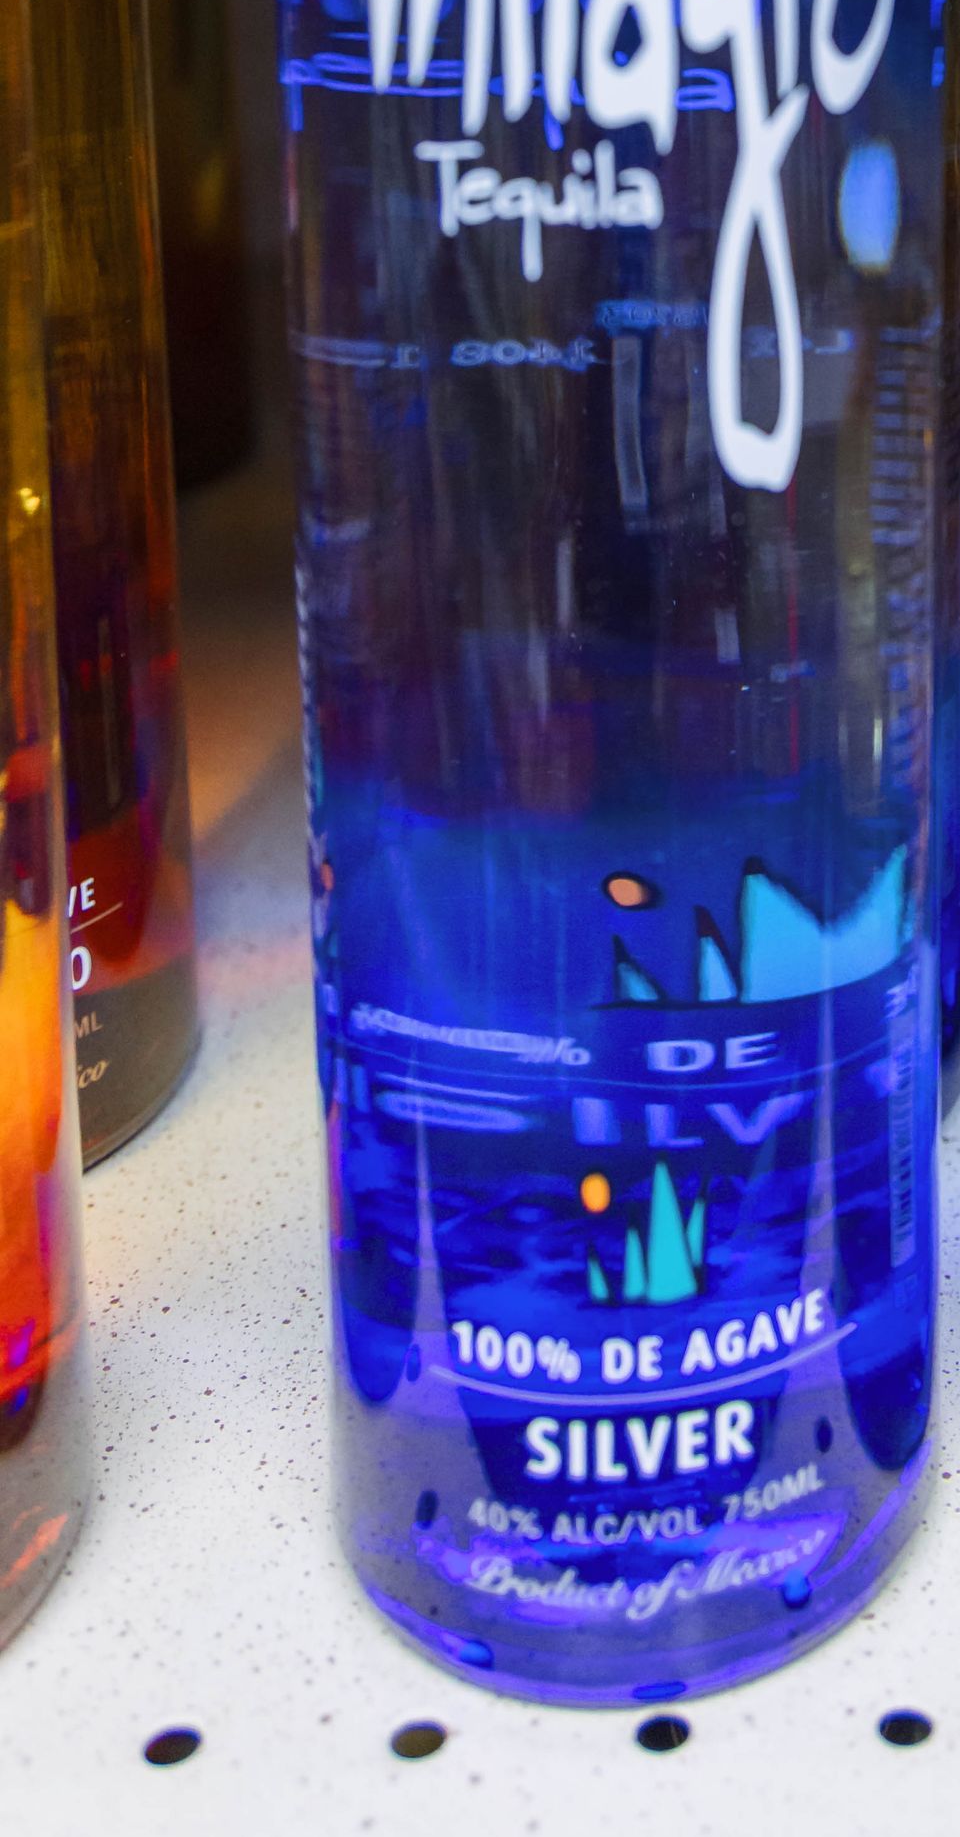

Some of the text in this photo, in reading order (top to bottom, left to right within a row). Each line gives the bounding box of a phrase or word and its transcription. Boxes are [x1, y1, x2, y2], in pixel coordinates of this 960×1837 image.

[413, 138, 665, 283] Tequila
[452, 1287, 827, 1384] 100% DE AGAVE
[524, 1399, 755, 1481] SILVER
[468, 1463, 826, 1545] 40% ALC/VOL 750ML
[467, 1553, 632, 1610] Product
[626, 1559, 696, 1621] of
